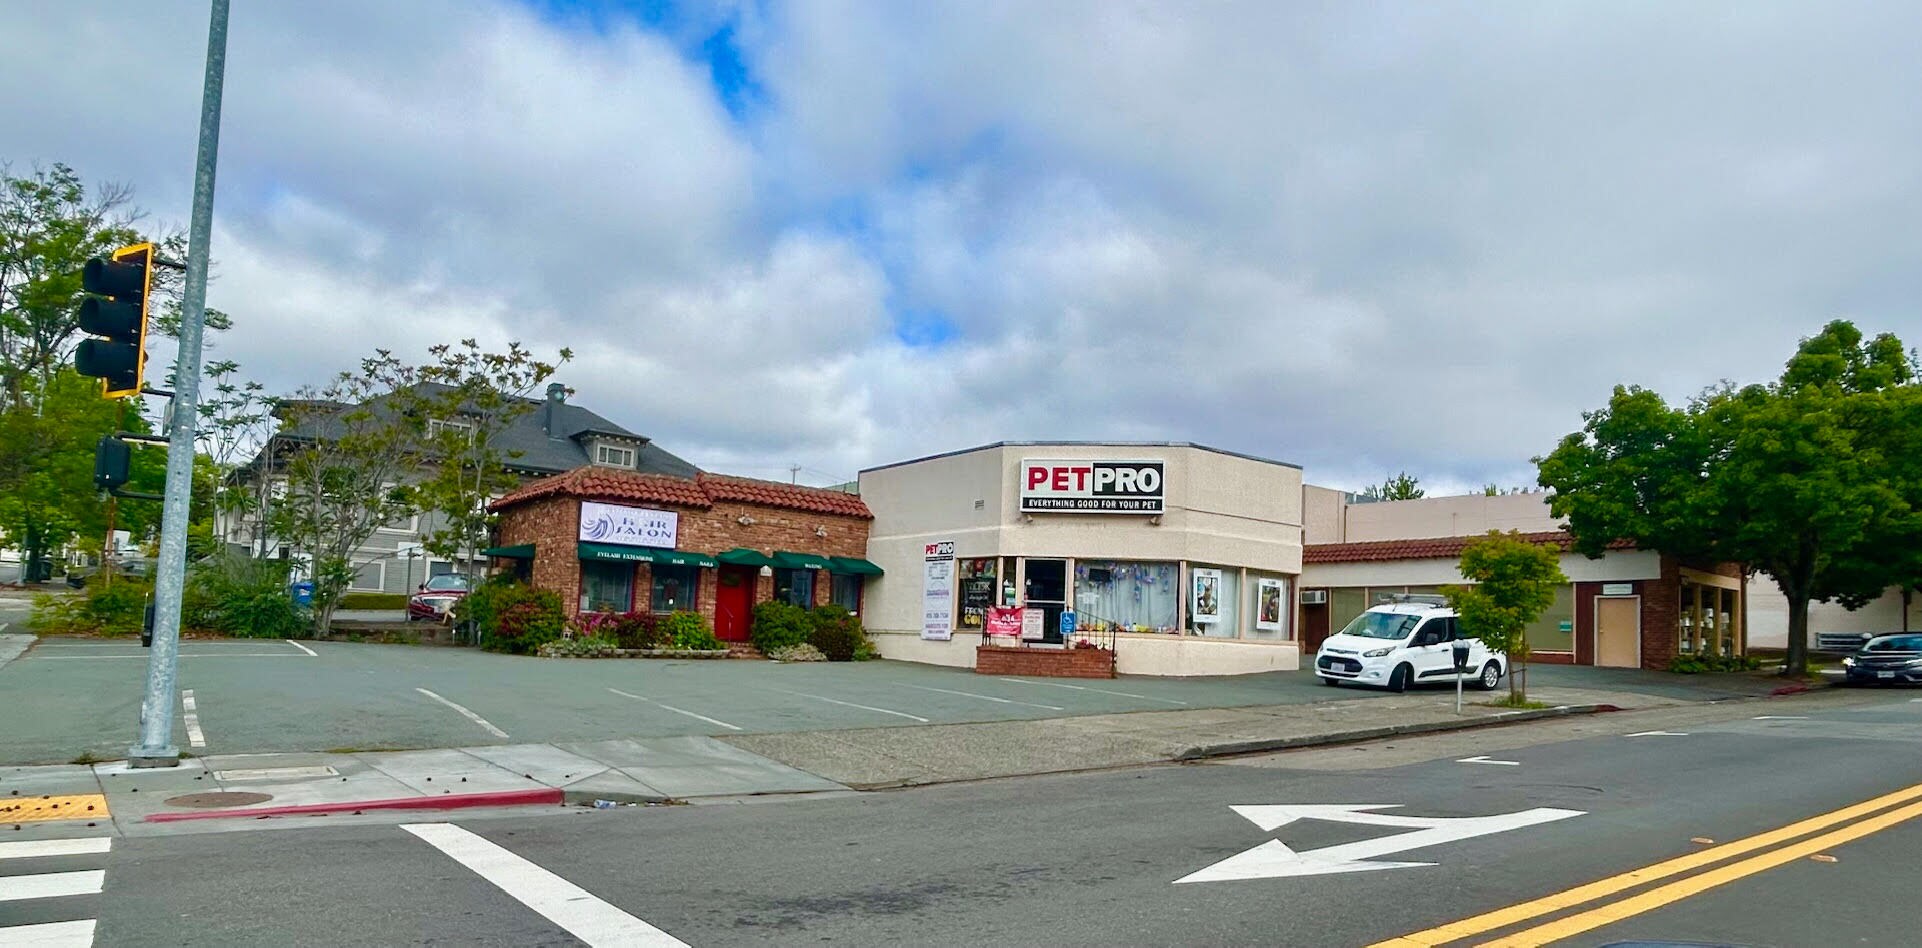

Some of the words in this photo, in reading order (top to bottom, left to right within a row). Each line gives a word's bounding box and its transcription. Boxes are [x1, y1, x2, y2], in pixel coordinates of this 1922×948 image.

[1028, 499, 1075, 507] EVERYTHING
[1077, 500, 1099, 508] GOOD
[1101, 500, 1117, 508] FOR
[1119, 501, 1139, 509] YOUR
[1142, 501, 1156, 509] PET
[622, 517, 667, 529] HIR
[616, 526, 672, 538] SALON
[597, 551, 621, 559] EYELASH
